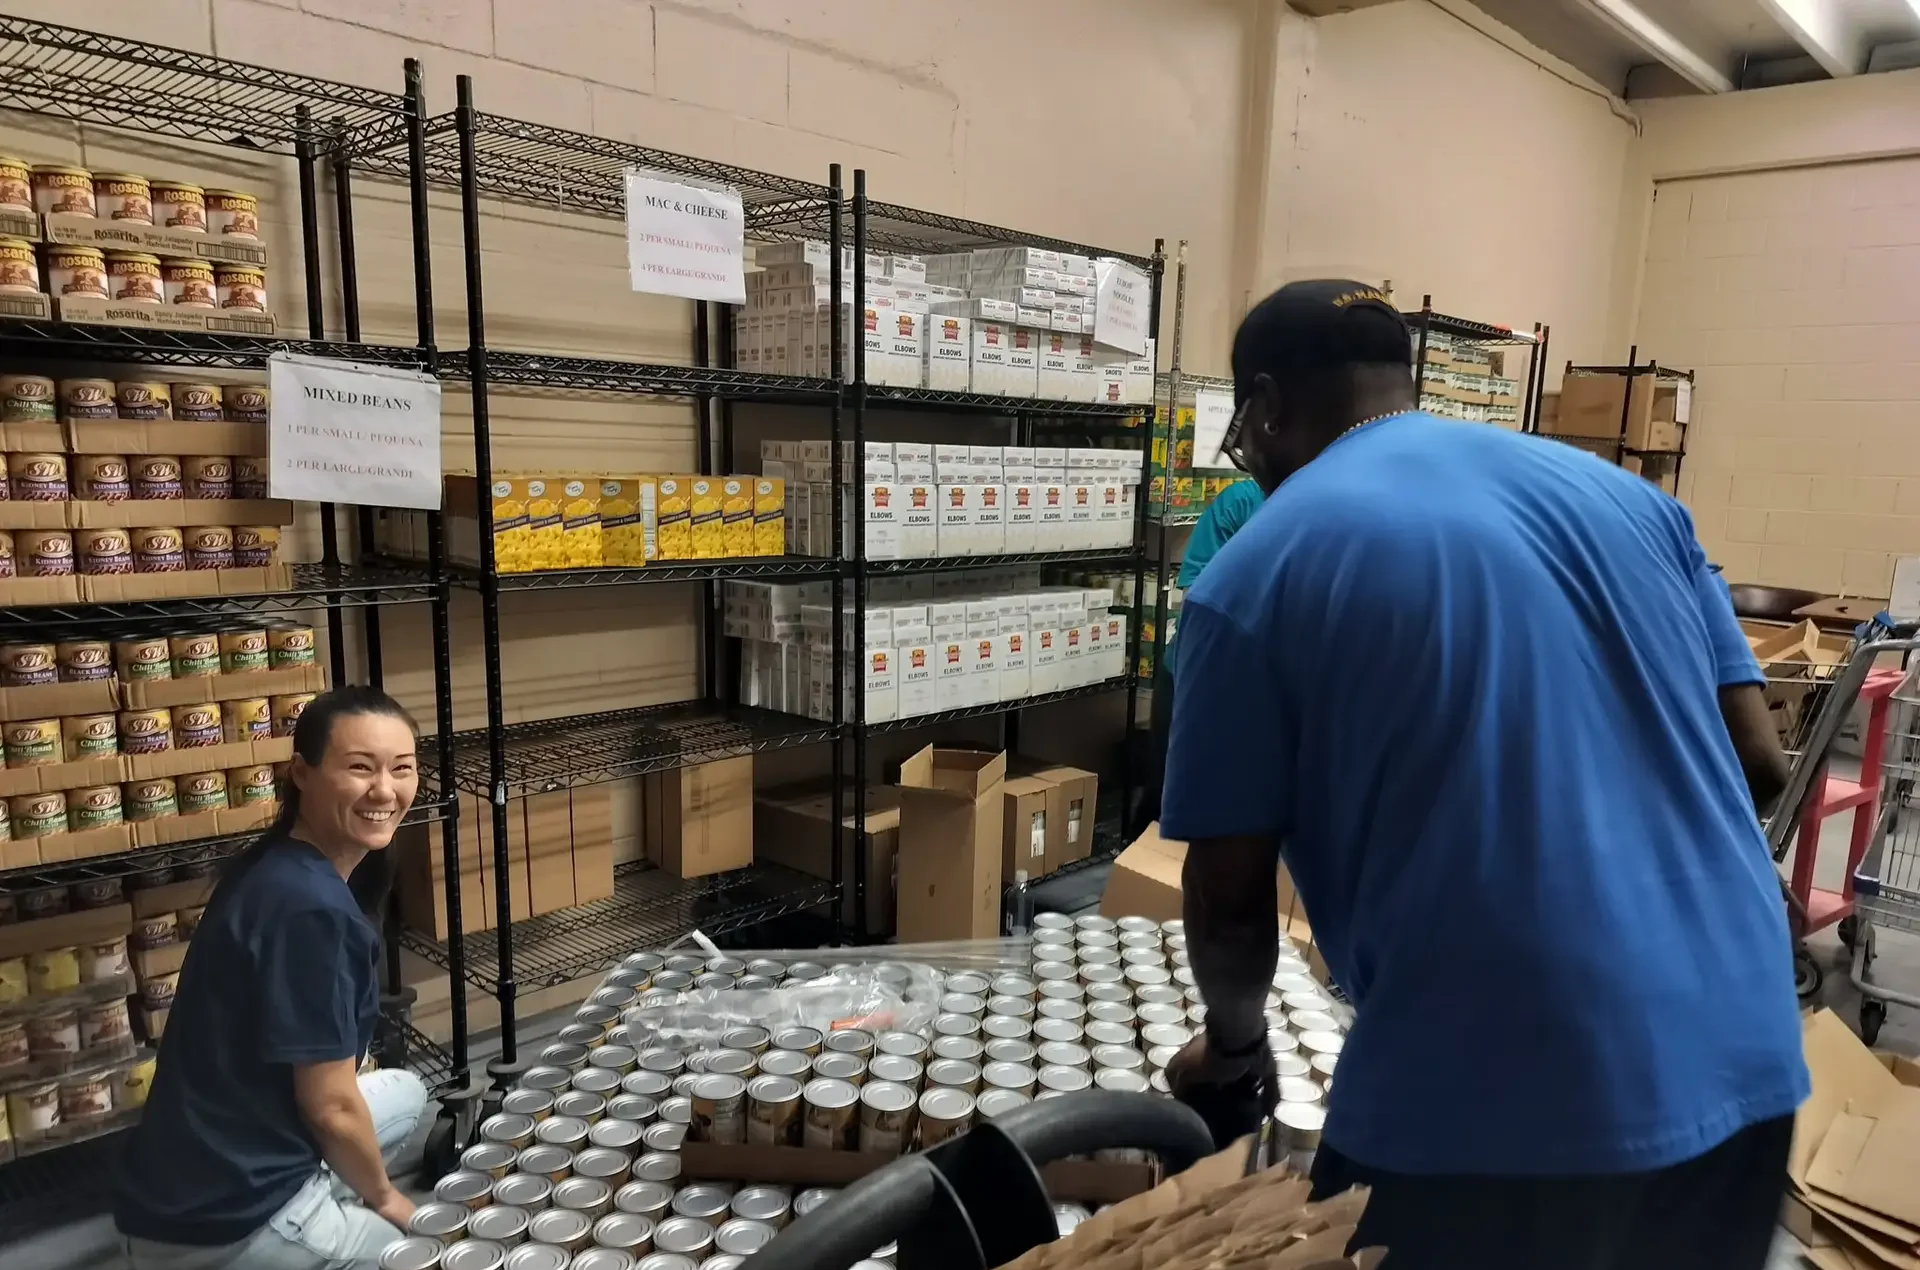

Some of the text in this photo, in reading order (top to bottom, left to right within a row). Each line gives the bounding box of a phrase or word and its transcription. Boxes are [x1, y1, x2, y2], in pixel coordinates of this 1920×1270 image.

[645, 195, 728, 220] MAC & CHEESE
[94, 229, 140, 244] Rosarita
[646, 234, 662, 244] PER
[220, 271, 263, 289] Rosarita
[105, 309, 150, 322] Rosarita
[894, 344, 916, 354] ELBOWS
[939, 347, 962, 357] ELBOWS
[982, 352, 1002, 362] ELBOWS
[1011, 356, 1032, 365] ELBOWS
[1047, 359, 1064, 369] ELBOWS
[1076, 363, 1094, 371] ELBOWS
[303, 385, 413, 412] MIXED BEANS
[295, 424, 320, 437] PER
[286, 458, 293, 468] 2
[296, 460, 320, 471] PER
[93, 482, 118, 490] KIDNEY
[870, 512, 893, 520] ELBOWS
[909, 515, 930, 523] ELBOWS
[1013, 513, 1031, 521] ELBOWS
[1044, 512, 1061, 520] ELBOWS
[1073, 511, 1089, 519] ELBOWS
[247, 550, 267, 558] BEANS
[69, 667, 109, 676] BLACK BEANS
[943, 666, 963, 676] ELBOWS
[976, 662, 994, 671] ELBOWS
[33, 671, 53, 679] BEANS
[908, 671, 929, 680] ELBOWS
[868, 680, 891, 690] ELBOWS
